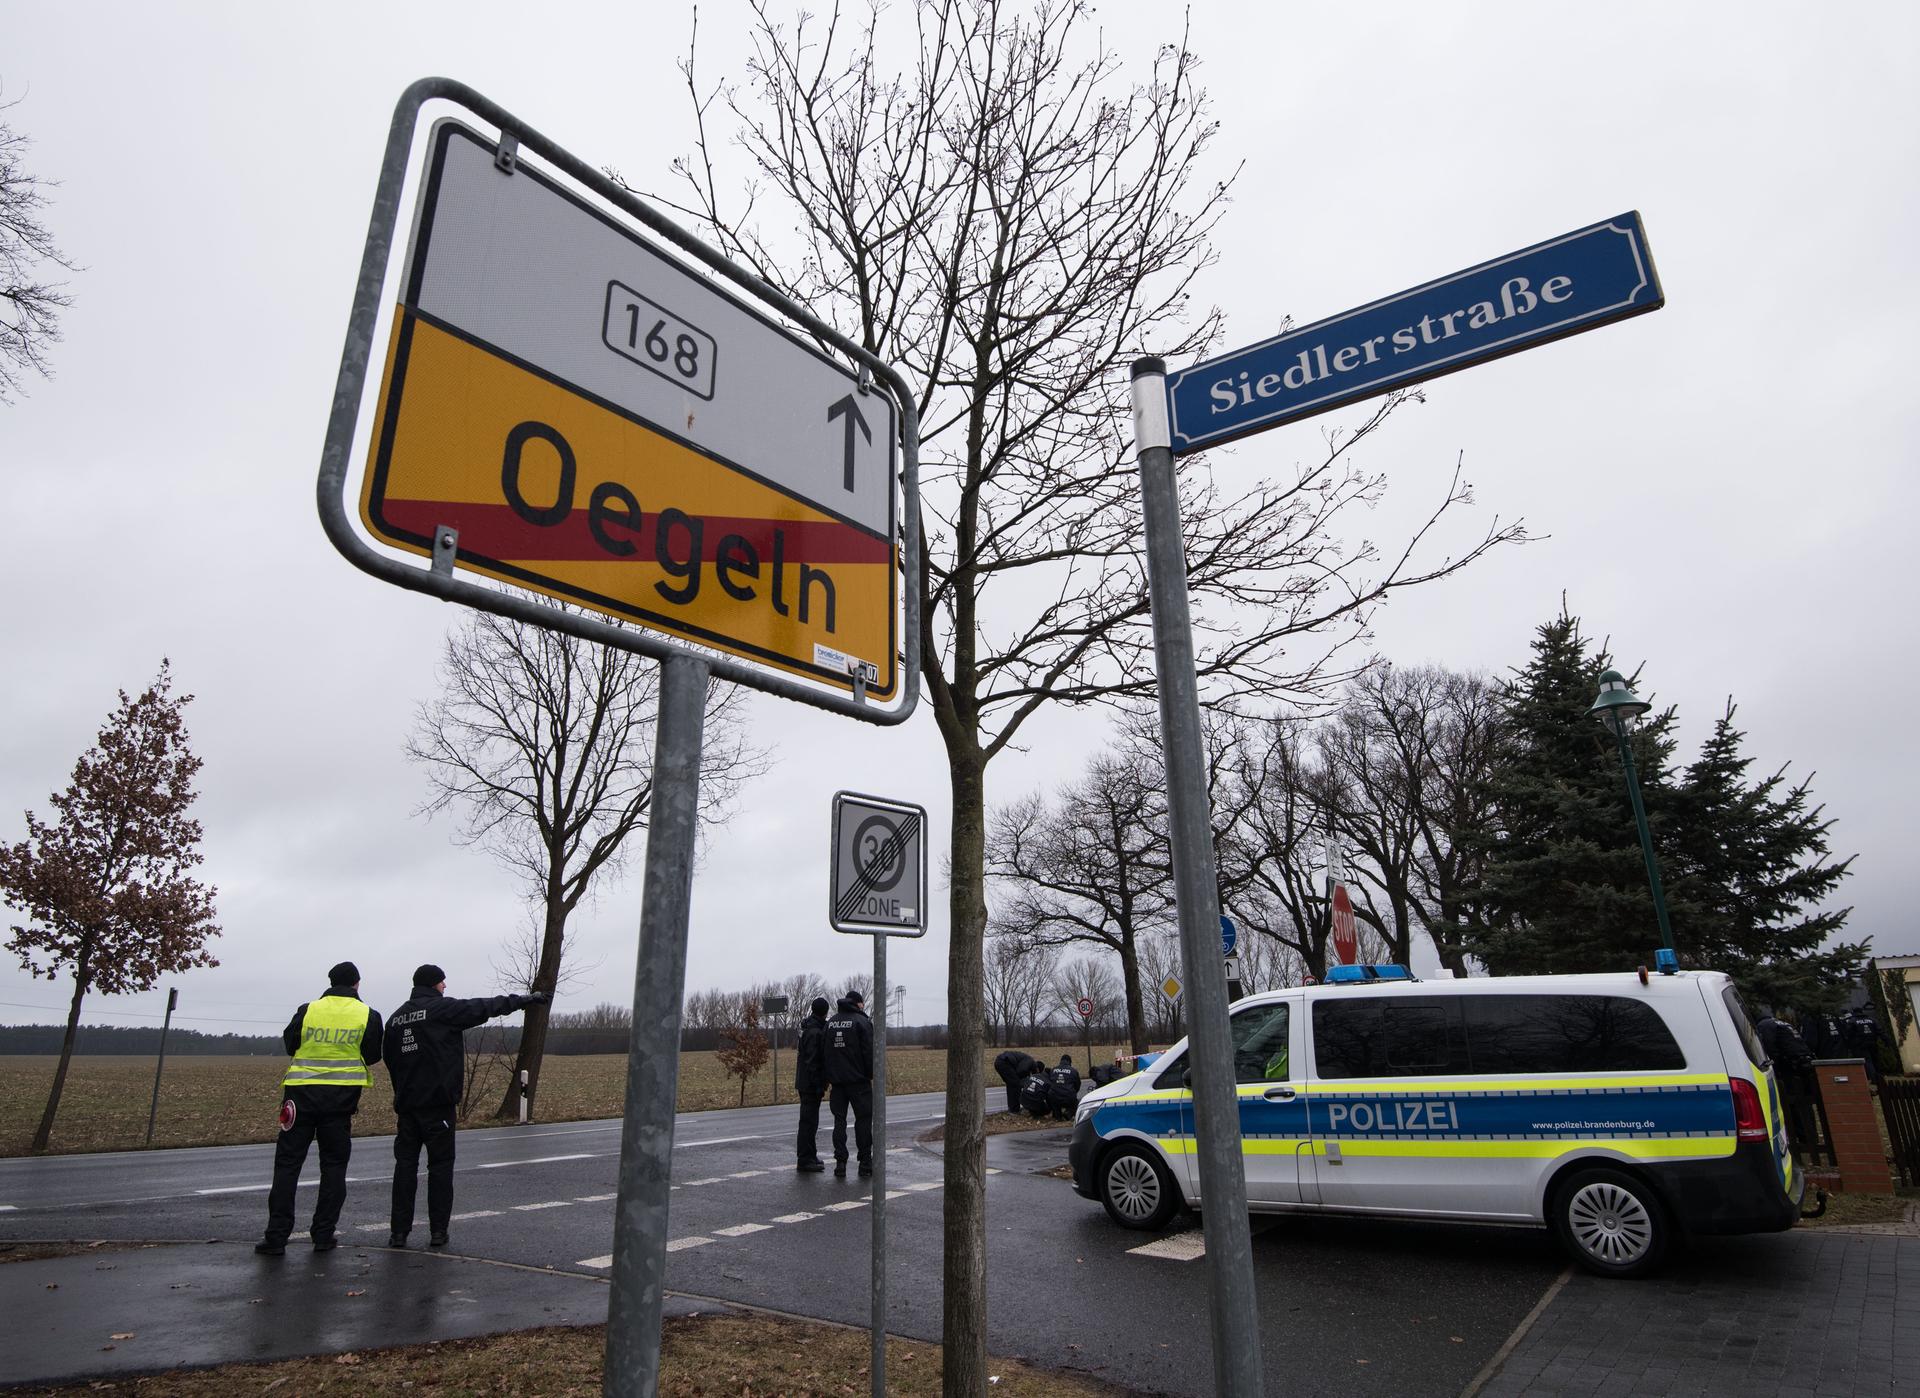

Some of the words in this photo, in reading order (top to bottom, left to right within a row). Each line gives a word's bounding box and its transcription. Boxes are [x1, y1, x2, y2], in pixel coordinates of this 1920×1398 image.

[626, 303, 699, 378] 168
[1209, 275, 1574, 415] Siedlerstraße
[501, 420, 837, 634] Oegeln
[858, 896, 900, 918] ZONE
[1334, 910, 1354, 943] STOP
[392, 1010, 427, 1027] POLIZEI
[828, 1020, 853, 1029] POLIZEI
[305, 1026, 362, 1045] POLIZEI
[1328, 1101, 1459, 1131] POLIZEI
[1532, 1120, 1656, 1131] www.polizei.brandenburg.de
